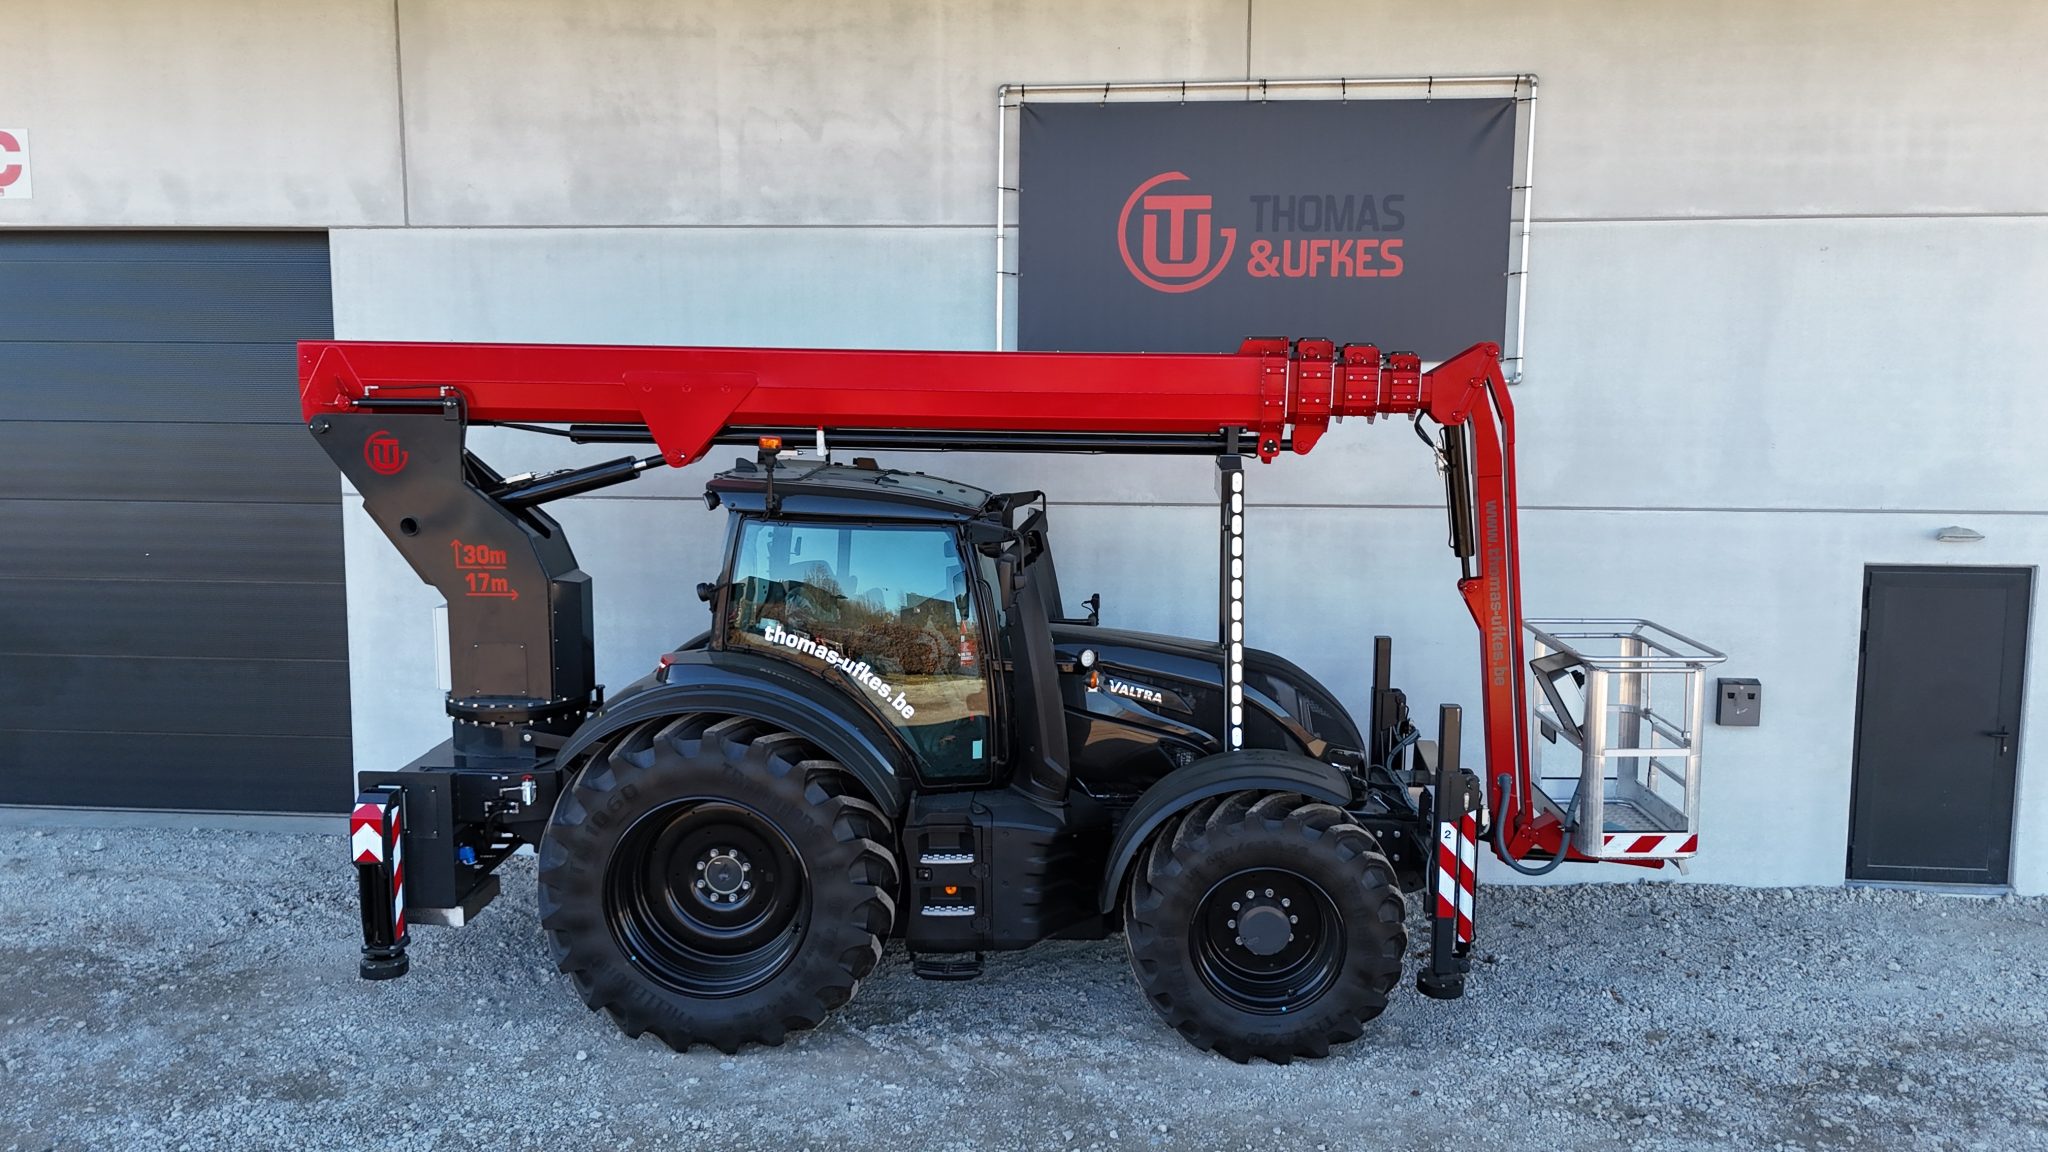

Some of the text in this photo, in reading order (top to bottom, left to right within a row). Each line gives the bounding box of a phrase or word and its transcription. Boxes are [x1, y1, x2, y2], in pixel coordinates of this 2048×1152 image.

[1251, 195, 1404, 233] THOMAS
[1248, 239, 1405, 278] &UFKES
[463, 544, 507, 565] 30m
[465, 572, 508, 592] 17m
[1486, 499, 1509, 686] www.thomas-ufkes.be
[764, 624, 916, 720] thomas-ufkes.be
[1109, 680, 1162, 704] VALTRA
[1444, 830, 1452, 839] 2
